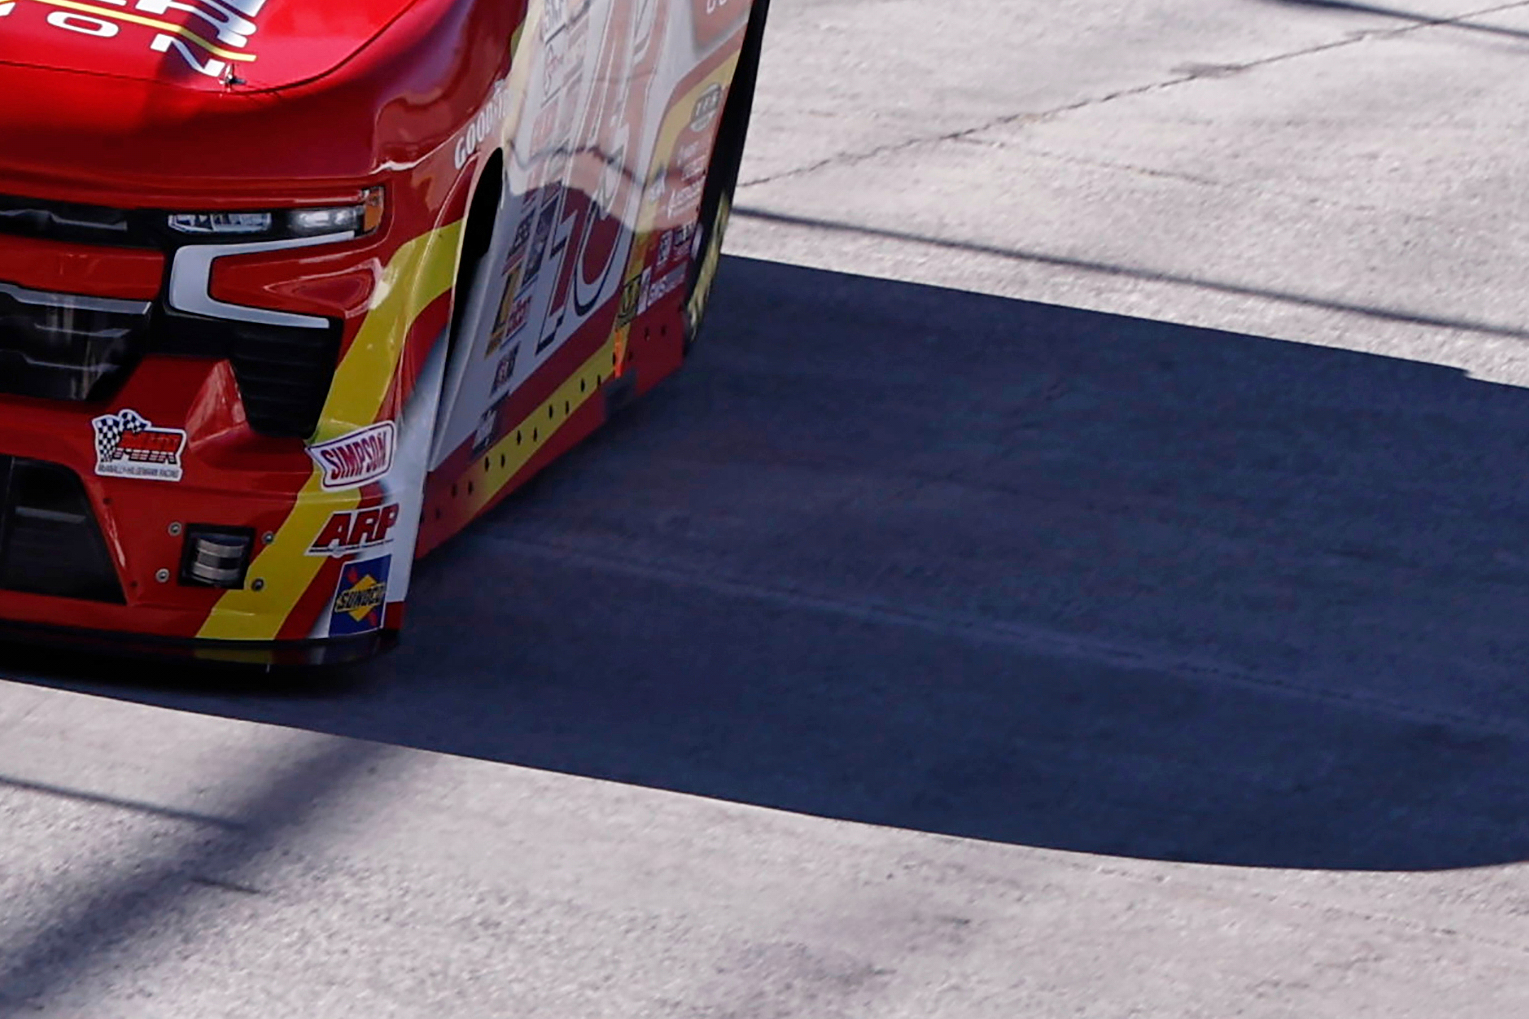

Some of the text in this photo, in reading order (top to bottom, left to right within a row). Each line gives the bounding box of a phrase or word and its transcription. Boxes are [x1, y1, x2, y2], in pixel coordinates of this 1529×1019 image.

[320, 431, 388, 481] SIMPSON
[311, 502, 400, 548] ARP
[336, 583, 384, 611] SUNOCO
